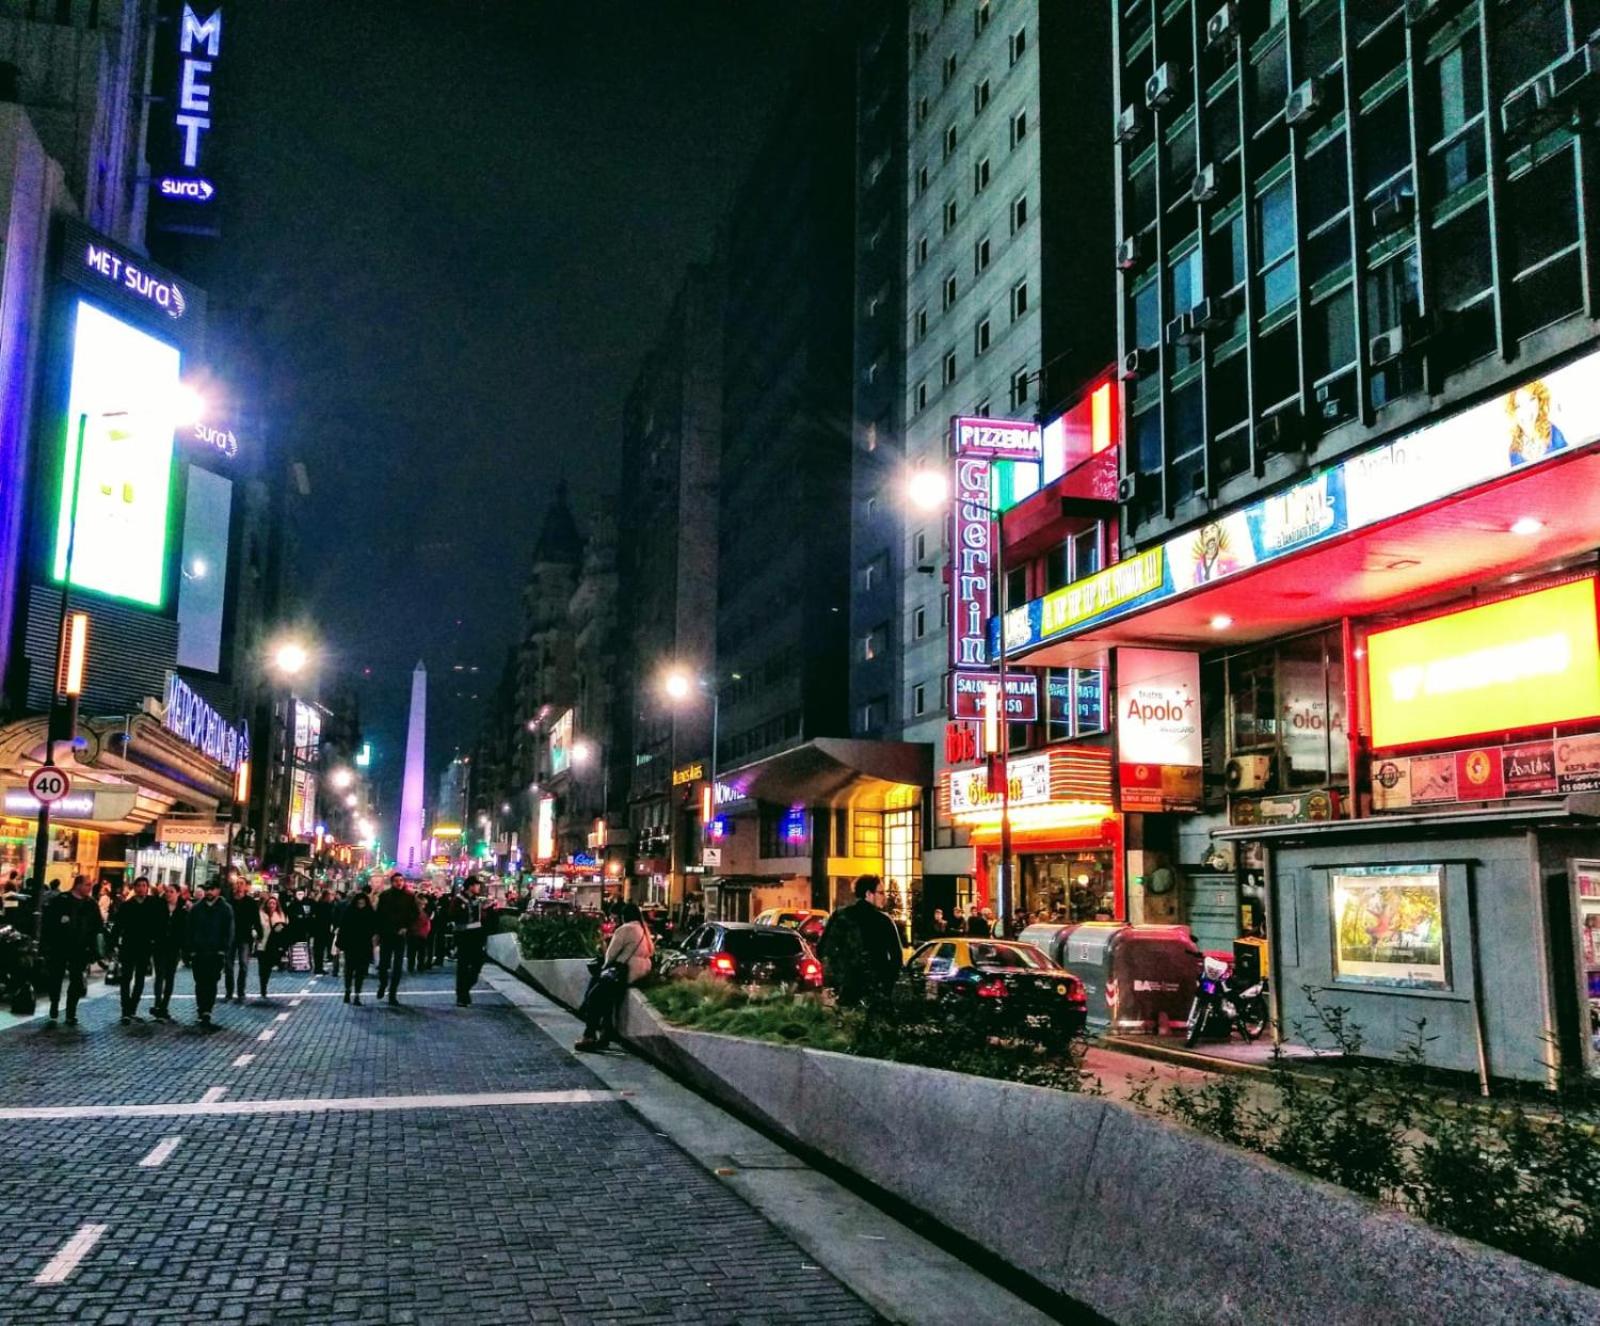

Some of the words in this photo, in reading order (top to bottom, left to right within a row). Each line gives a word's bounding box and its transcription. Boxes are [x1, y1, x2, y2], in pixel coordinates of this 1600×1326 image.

[176, 2, 222, 167] MET
[161, 178, 199, 196] sura
[88, 243, 122, 279] MET
[125, 265, 169, 307] sura
[194, 423, 227, 449] sura
[961, 425, 1040, 452] PIZZERIA
[1127, 699, 1184, 725] Apolo
[36, 777, 62, 794] 40
